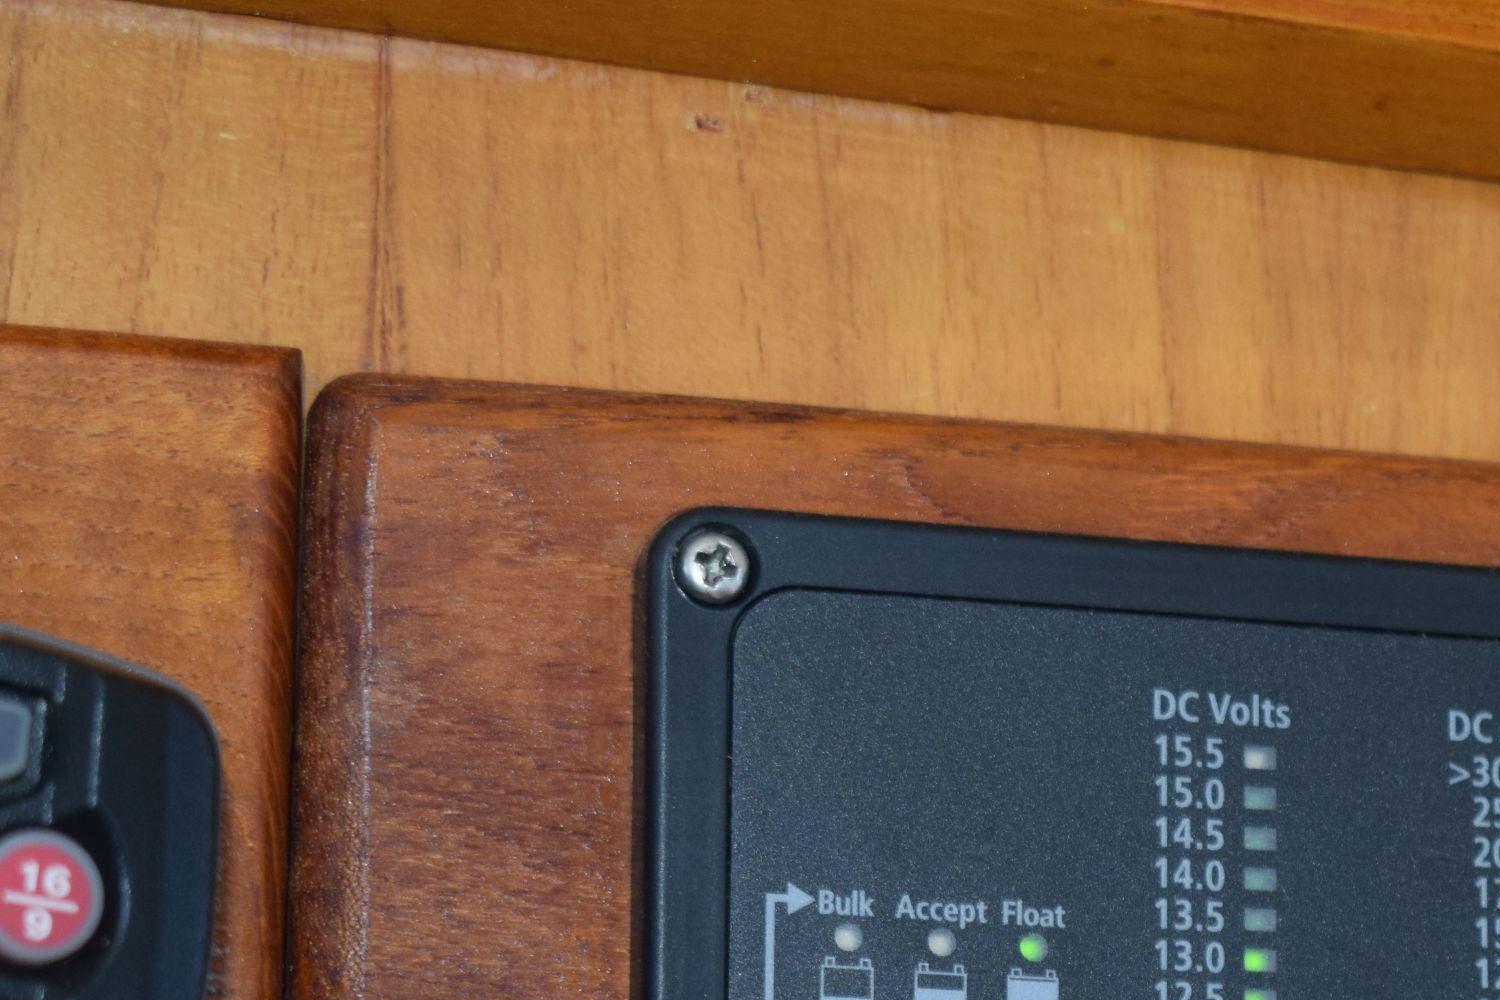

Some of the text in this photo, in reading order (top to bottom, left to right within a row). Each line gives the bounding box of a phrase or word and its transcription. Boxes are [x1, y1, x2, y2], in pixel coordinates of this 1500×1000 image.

[1153, 689, 1290, 728] DC Volts
[1448, 710, 1492, 743] DC
[1155, 734, 1224, 769] 15.5
[1155, 775, 1224, 810] 15.0
[1155, 816, 1224, 850] 14.5
[22, 860, 72, 898] 16
[1155, 857, 1225, 891] 14.0
[818, 889, 873, 916] Bulk
[895, 894, 987, 929] Accept
[1001, 899, 1065, 928] Float
[1155, 898, 1224, 932] 13.5
[24, 909, 53, 942] 9
[1155, 939, 1225, 973] 13.0
